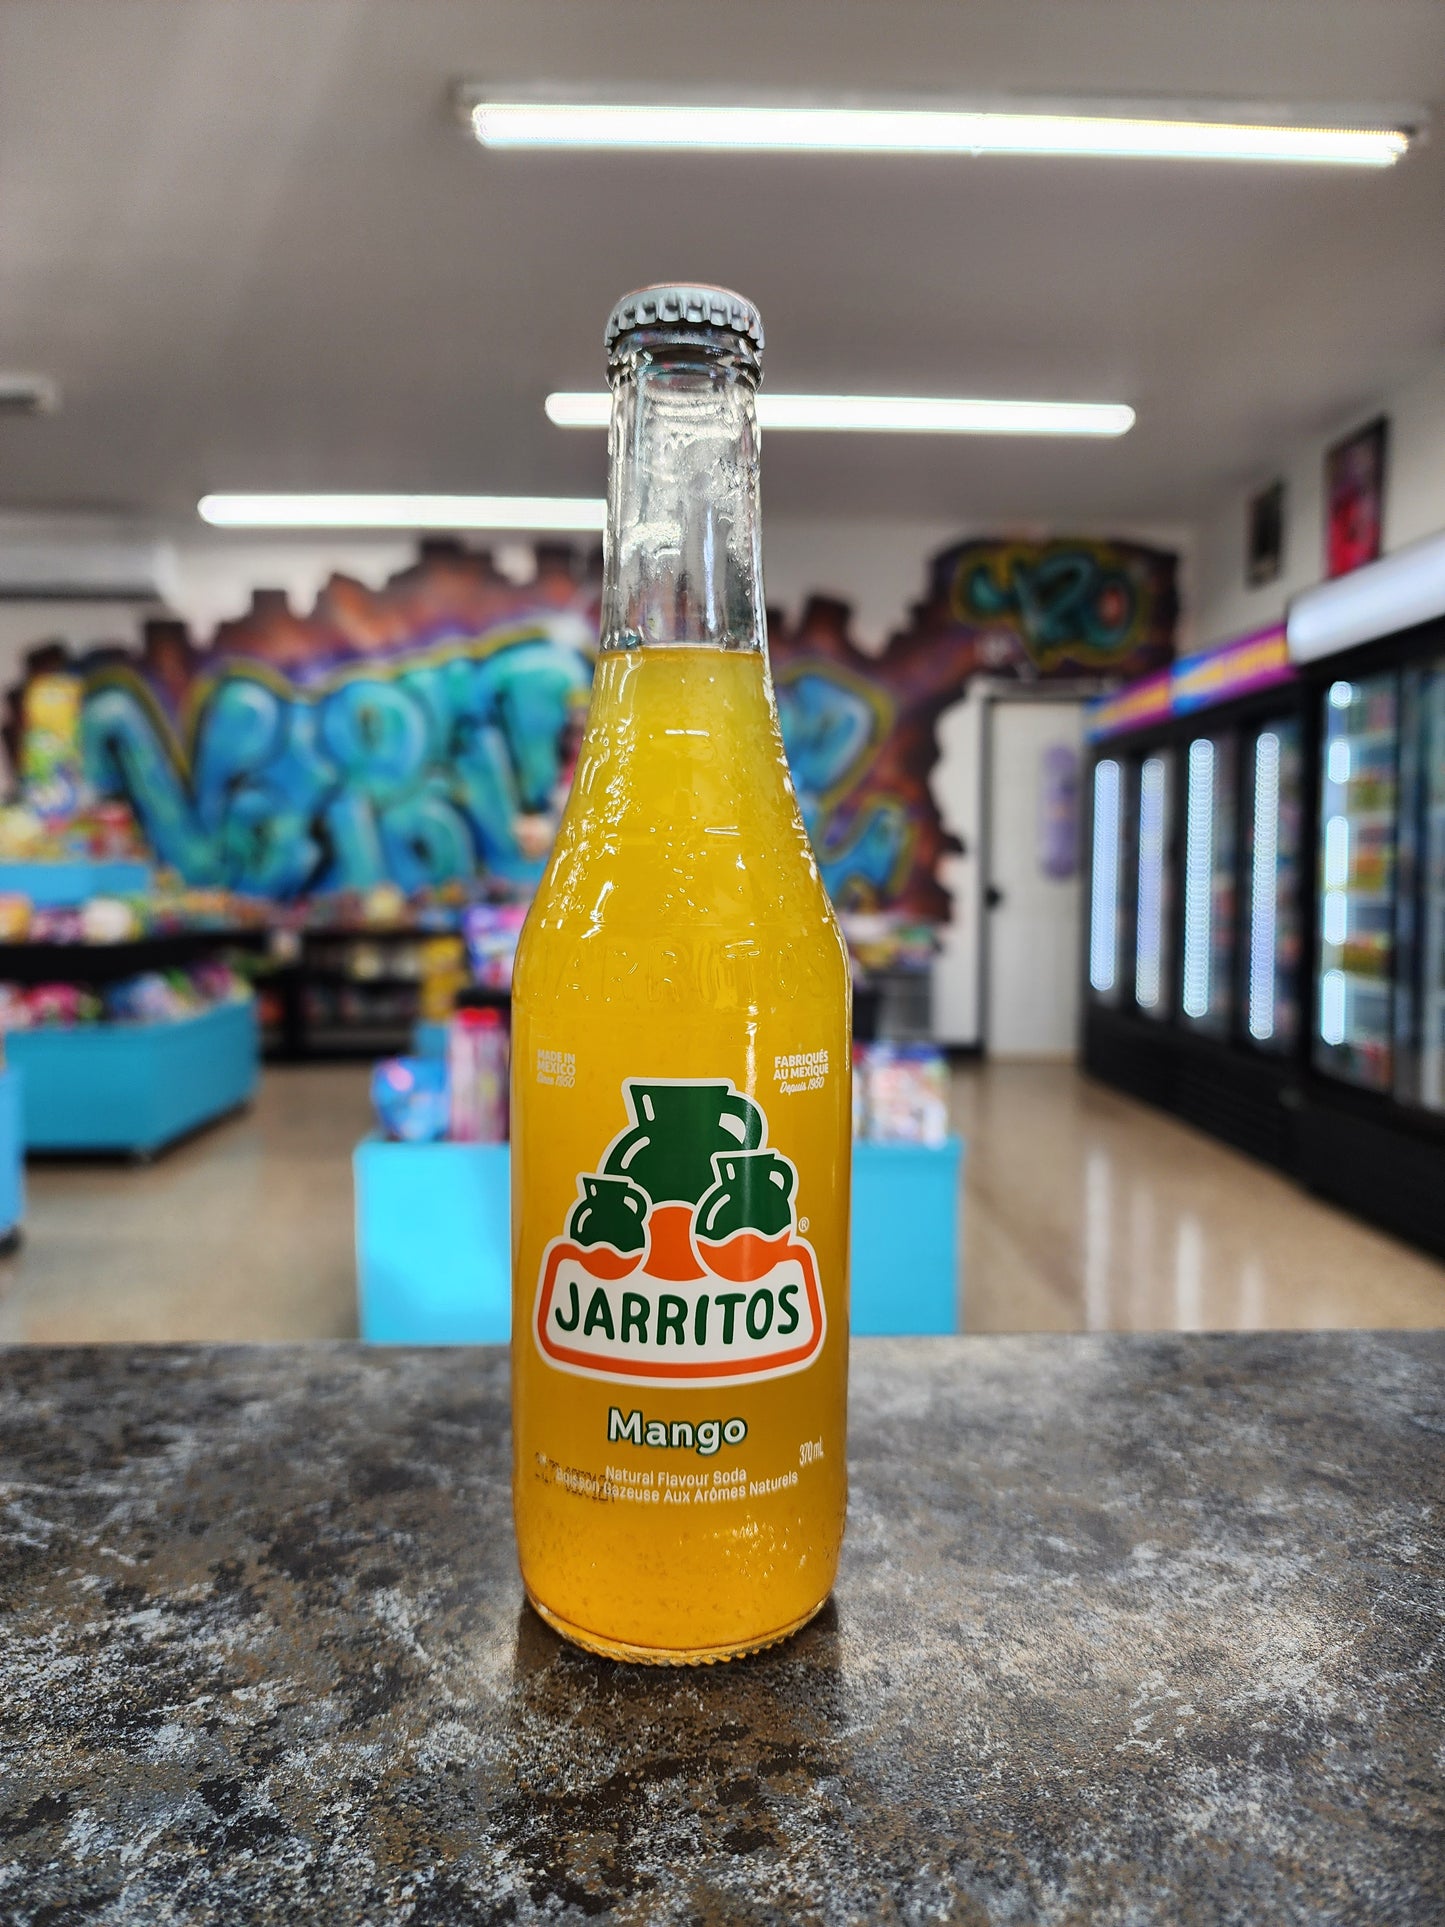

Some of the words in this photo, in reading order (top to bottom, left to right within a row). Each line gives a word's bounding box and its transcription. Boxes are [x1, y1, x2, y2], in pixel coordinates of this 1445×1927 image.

[537, 1048, 562, 1063] MADE
[564, 1052, 576, 1065] IN
[774, 1048, 829, 1069] FABRIQUÉS
[536, 1060, 577, 1077] MEXICO
[773, 1068, 788, 1081] AU
[790, 1063, 829, 1079] MEXIQUE
[779, 1080, 807, 1096] Depuis
[555, 1282, 800, 1346] JARRITOS
[608, 1406, 748, 1457] Mango
[799, 1440, 813, 1466] 370
[558, 1467, 600, 1494] Boisson
[603, 1481, 660, 1502] Gazeuse
[663, 1487, 691, 1504] Aux
[693, 1484, 746, 1504] Arômes
[749, 1471, 799, 1496] Naturels
[605, 1465, 654, 1486] Natural
[657, 1470, 709, 1488] Flavour
[713, 1467, 747, 1485] Soda
